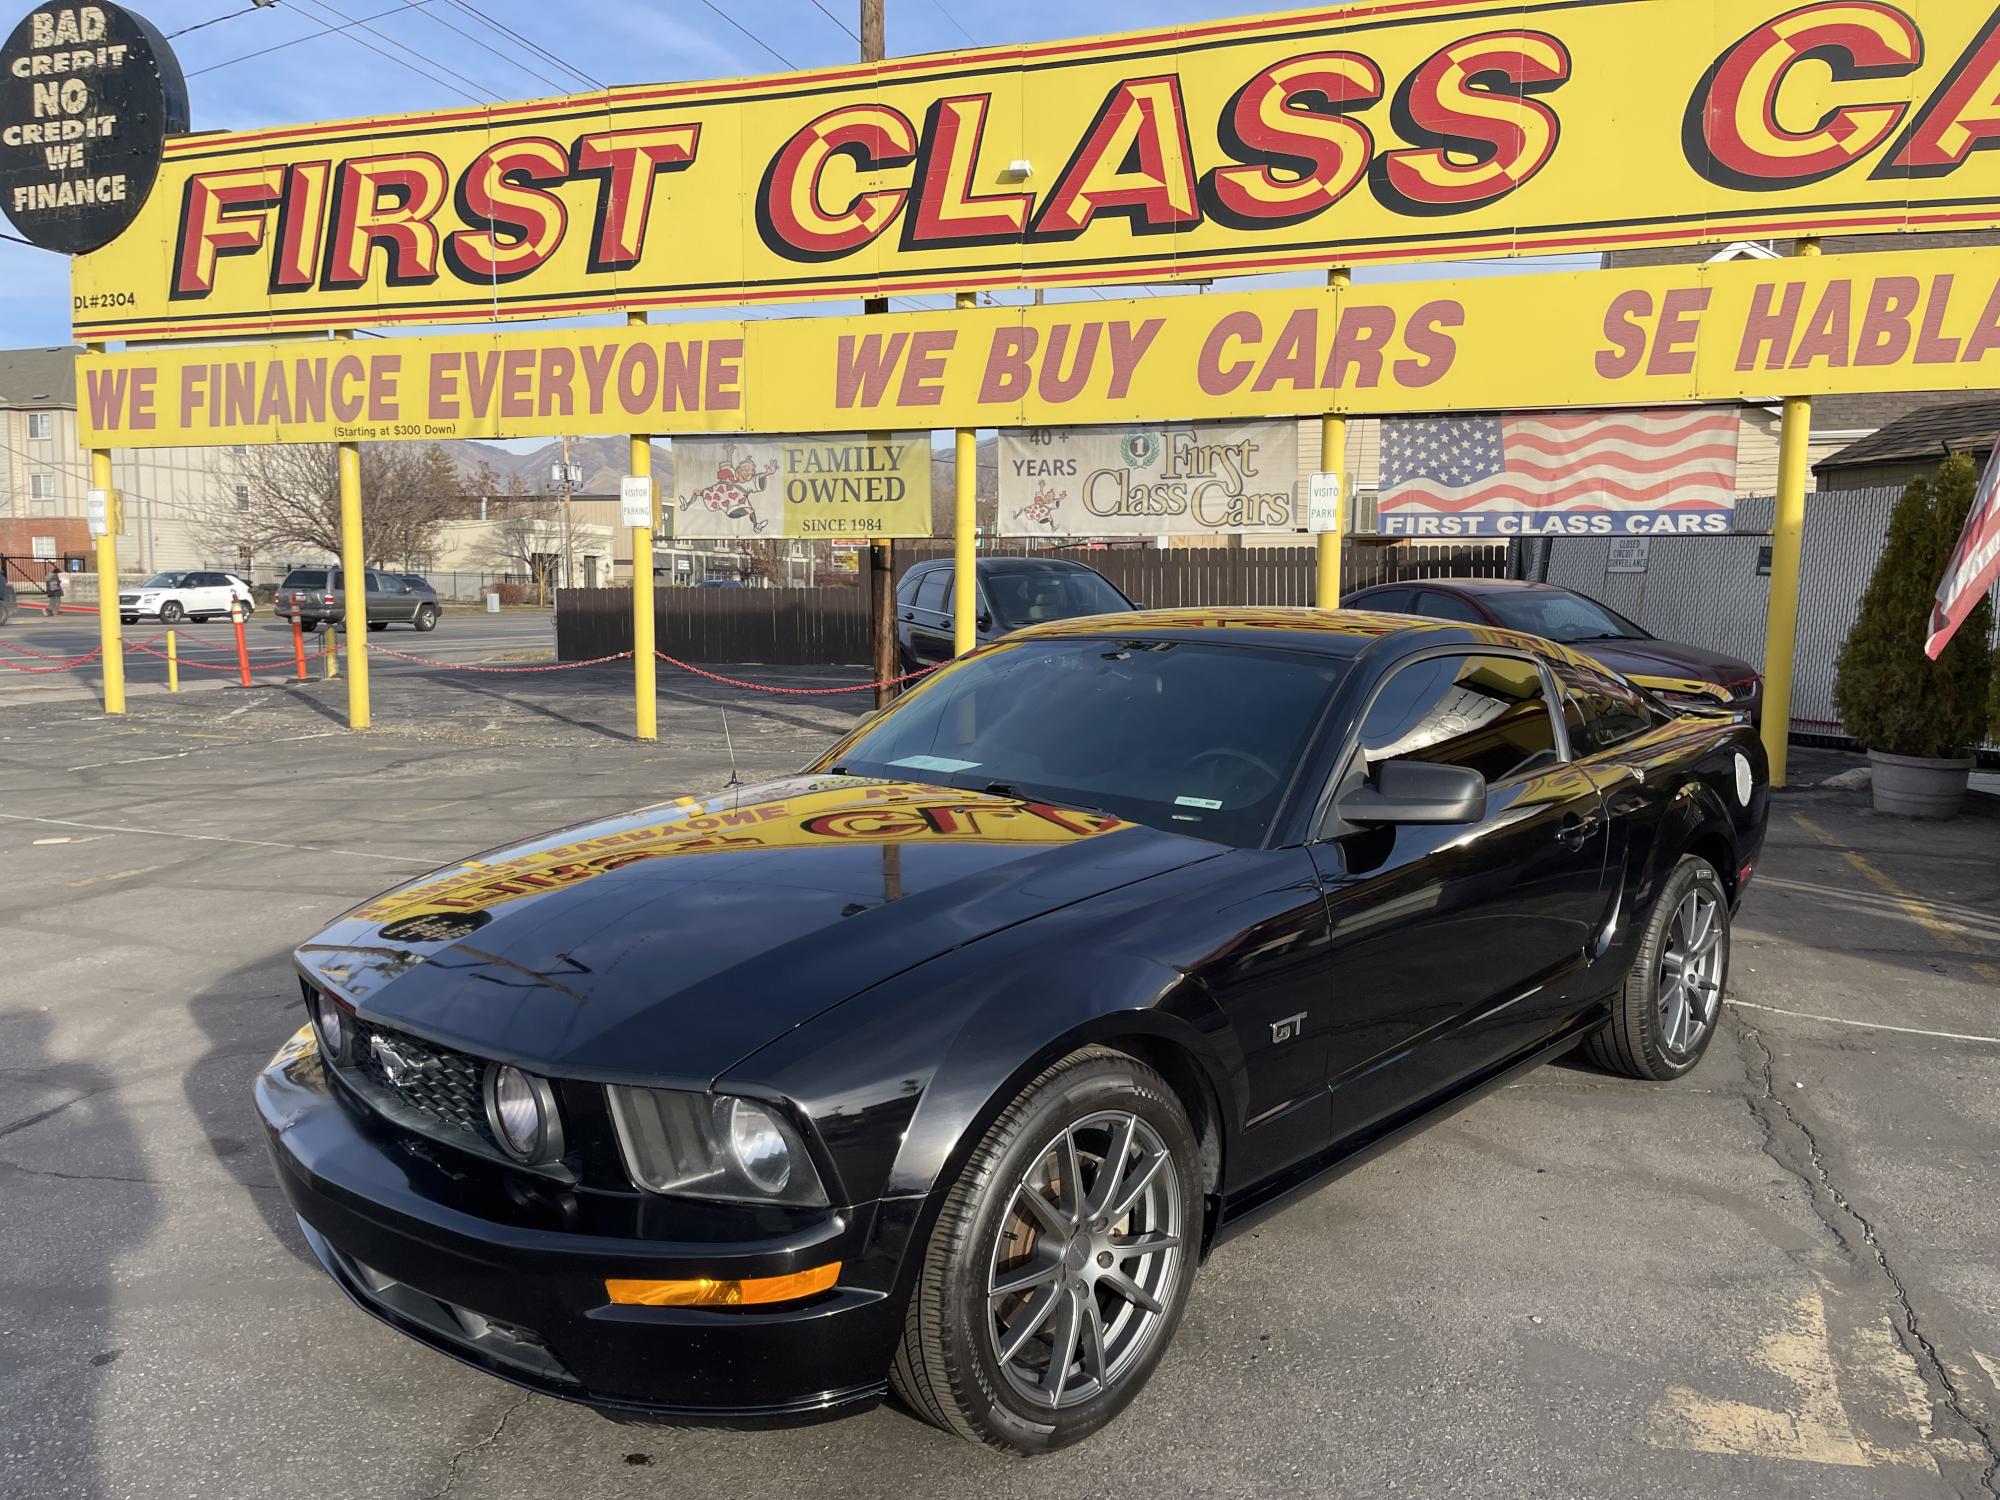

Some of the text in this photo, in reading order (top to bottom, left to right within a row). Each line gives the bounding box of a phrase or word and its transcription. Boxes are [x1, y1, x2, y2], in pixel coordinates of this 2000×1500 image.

[32, 6, 107, 49] BAD
[12, 44, 128, 79] CREDIT
[33, 78, 89, 118] NO
[3, 115, 117, 146] CREDIT
[45, 143, 84, 170] WE
[169, 122, 702, 302] FIRST
[755, 28, 1572, 264] CLASS
[13, 175, 127, 212] FINANCE
[74, 292, 135, 310] DL#2304
[1594, 287, 1713, 379] SE
[835, 299, 1465, 409] WE BUY CARS
[86, 338, 743, 431] WE FINANCE EVERYONE
[334, 423, 456, 438] (Starting at $300 Down)
[1029, 429, 1051, 446] 40
[787, 446, 905, 474] FAMILY
[1012, 458, 1078, 477] YEARS
[1160, 429, 1259, 498] First
[624, 488, 648, 497] VISITOR
[787, 475, 906, 504] OWNED
[1082, 467, 1290, 528] Class Cars
[1314, 487, 1342, 498] VISITO
[623, 506, 650, 516] PARKING
[802, 518, 882, 532] SINCE 1984
[1385, 513, 1729, 535] FIRST CLASS CARS
[1619, 539, 1641, 549] CLOSED
[1270, 1011, 1308, 1044] GT
